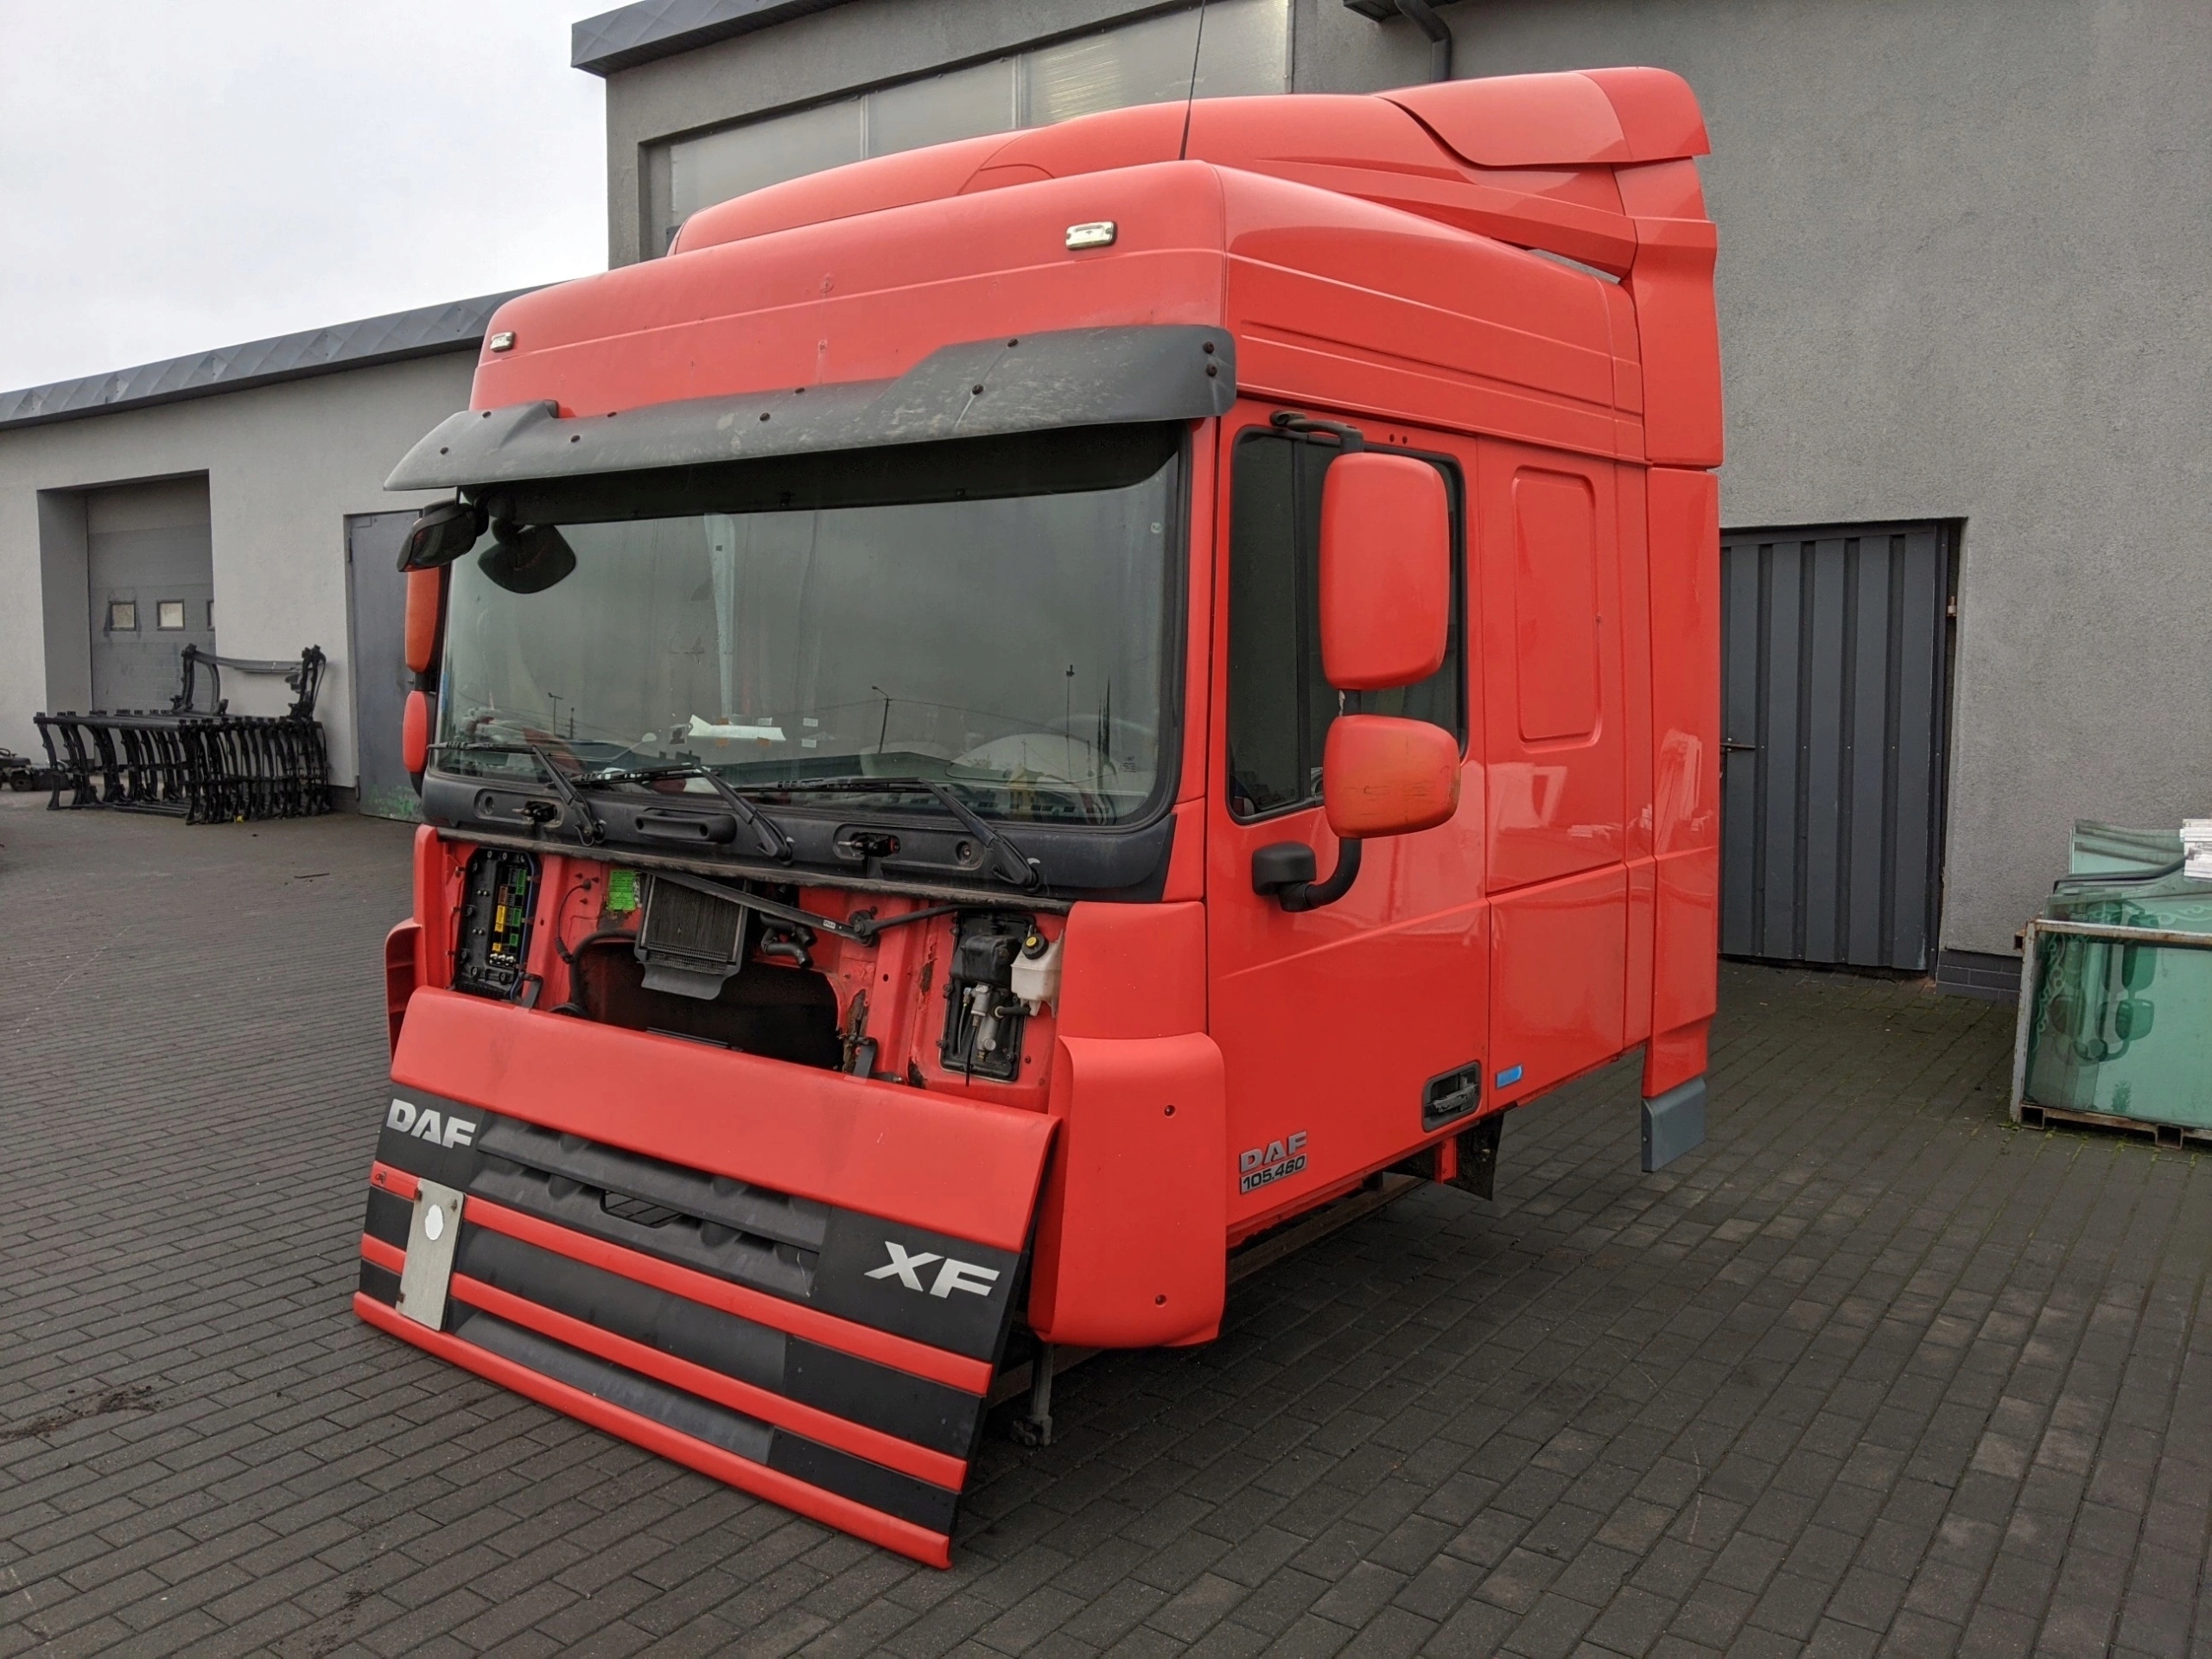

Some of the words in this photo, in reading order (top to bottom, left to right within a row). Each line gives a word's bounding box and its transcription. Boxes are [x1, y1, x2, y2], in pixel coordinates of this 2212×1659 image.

[386, 1098, 476, 1149] DAF
[1240, 1131, 1307, 1173] DAF
[1243, 1154, 1306, 1190] 105.460
[864, 1241, 1001, 1299] XF
